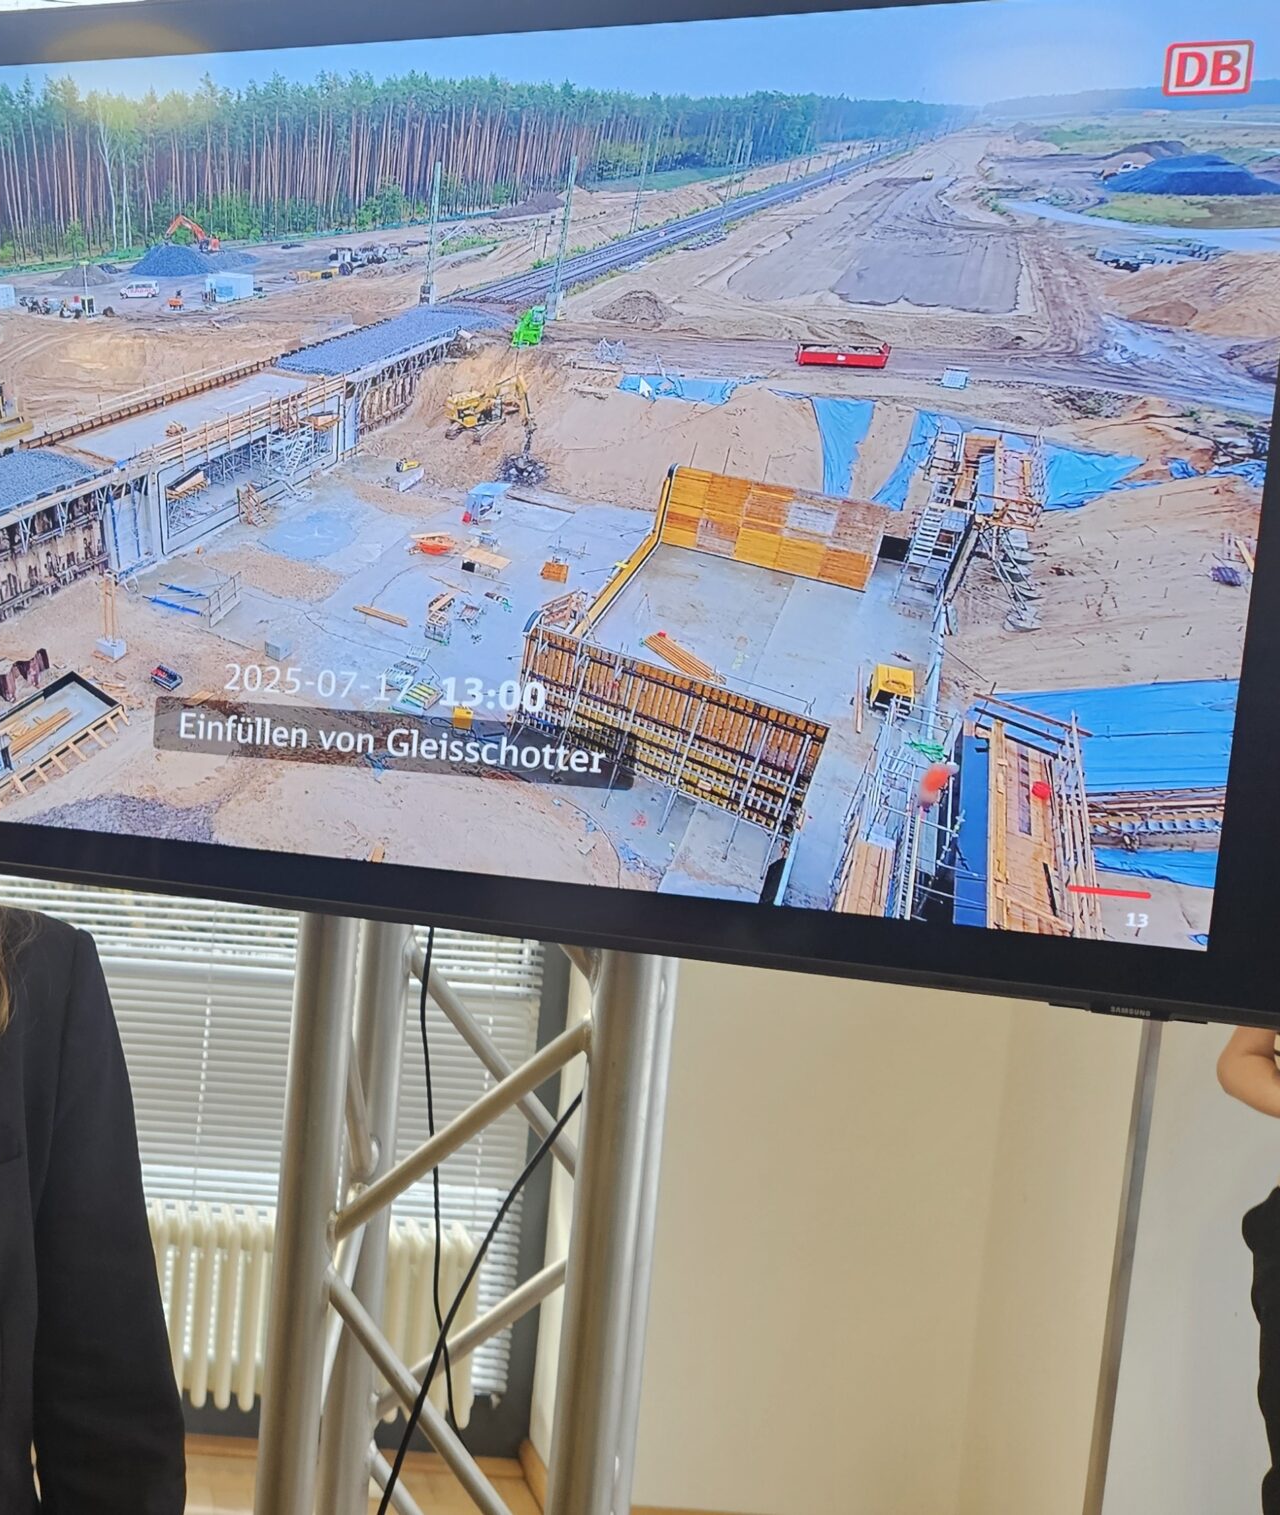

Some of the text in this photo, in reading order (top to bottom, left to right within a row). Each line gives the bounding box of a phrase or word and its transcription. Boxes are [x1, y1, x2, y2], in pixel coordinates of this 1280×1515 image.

[1173, 48, 1243, 89] DB
[223, 662, 547, 713] 2025-07-17 13:00
[179, 711, 608, 776] Einfüllen von Gleisschotter
[1125, 911, 1150, 929] 13
